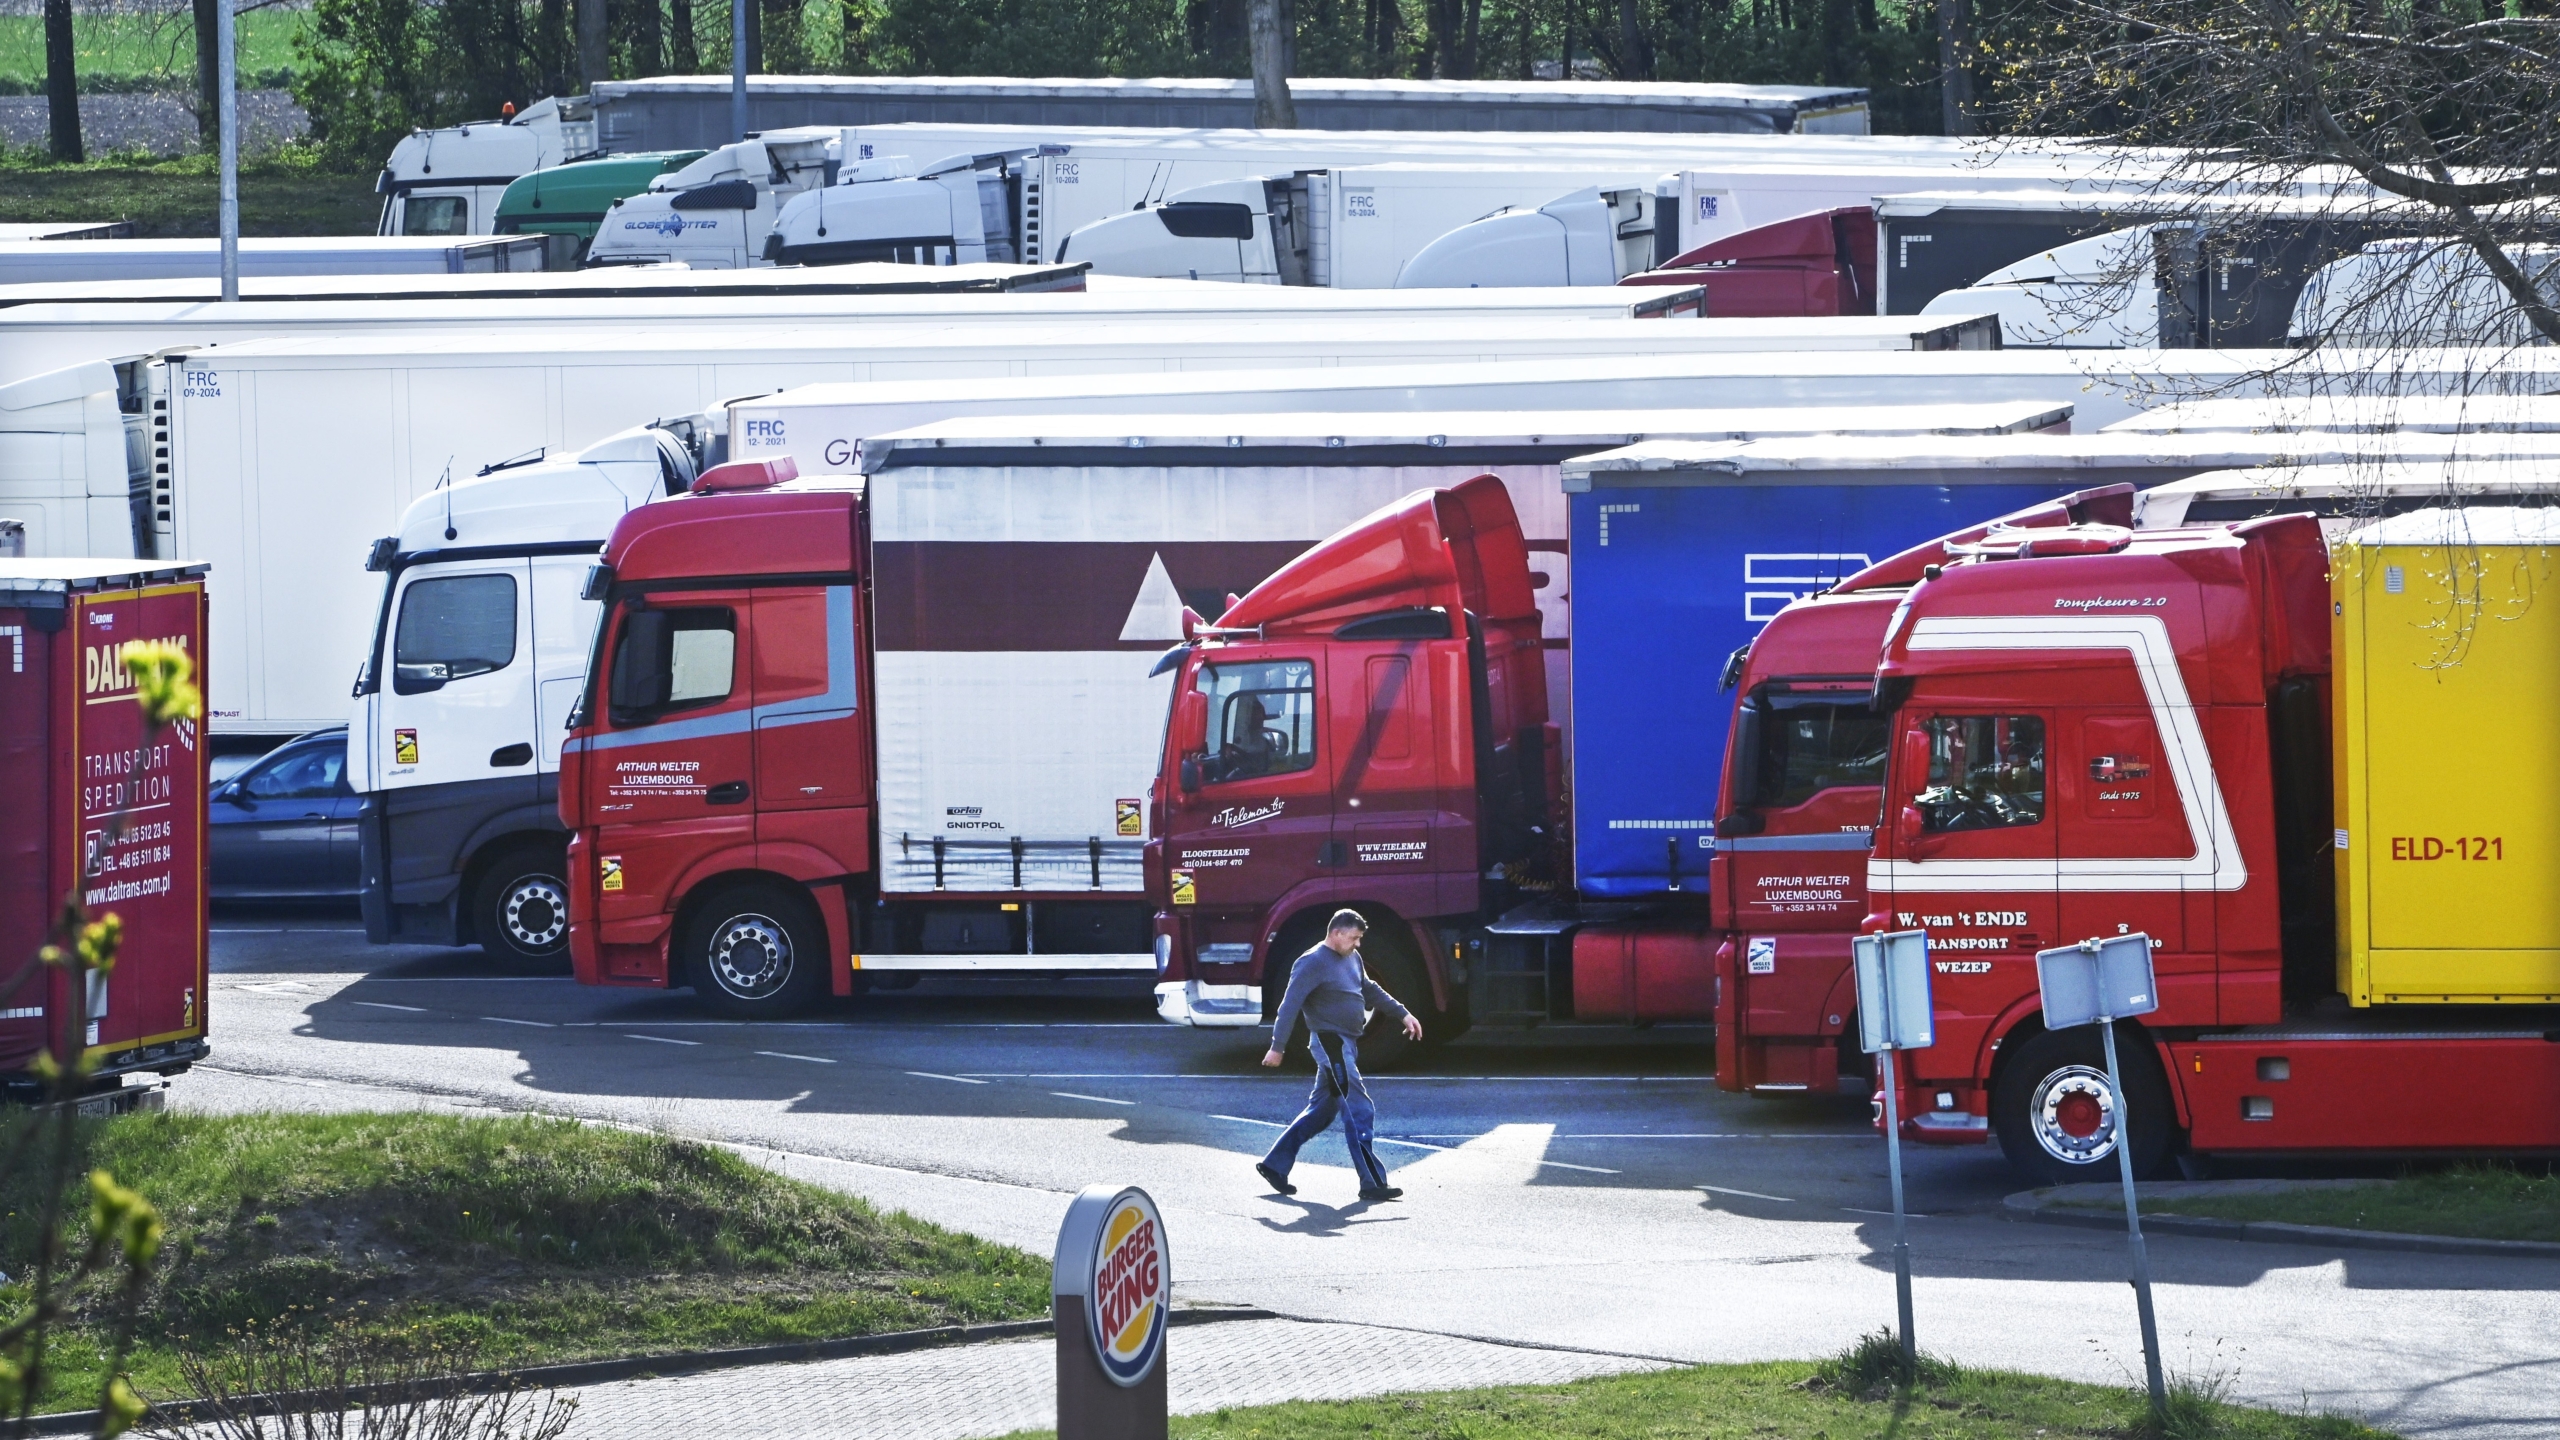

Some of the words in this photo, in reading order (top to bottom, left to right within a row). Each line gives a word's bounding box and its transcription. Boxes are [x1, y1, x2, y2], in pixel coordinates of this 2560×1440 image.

[860, 144, 874, 156] FRC
[1055, 163, 1079, 175] FRC
[1055, 176, 1079, 184] 10-2026
[1350, 196, 1374, 208] FRC
[1700, 196, 1717, 209] FRC
[1348, 209, 1375, 217] 05-2024
[187, 371, 218, 387] FRC
[747, 420, 785, 436] FRC
[765, 437, 786, 446] 2021
[2054, 597, 2139, 611] Pompkeure
[2142, 597, 2167, 607] 2.0
[95, 613, 114, 624] KRONE
[85, 744, 170, 778] TRANSPORT
[616, 762, 657, 772] ARTHUR
[660, 762, 700, 771] WELTER
[623, 775, 694, 785] LUXEMBOURG
[85, 775, 170, 811] SPEDITION
[2122, 791, 2140, 799] 1975
[1221, 806, 1271, 828] Tieleman
[946, 821, 1005, 829] GNIOTPOL
[131, 826, 139, 843] 65
[140, 824, 152, 842] 512
[153, 822, 161, 839] 23
[162, 820, 170, 837] 45
[1182, 848, 1250, 858] KLOOSTERZANDE
[1356, 842, 1427, 852] WWW.TIELEMAN
[2391, 837, 2503, 860] ELD-121
[87, 839, 100, 869] PL
[102, 855, 117, 872] TEL.
[118, 852, 130, 870] +48
[131, 850, 140, 868] 65
[141, 848, 152, 865] 511
[153, 846, 161, 863] 06
[162, 844, 170, 861] 84
[1360, 852, 1424, 862] TRANSPORT.NL
[1757, 876, 1803, 887] ARTHUR
[1805, 875, 1850, 886] WELTER
[85, 870, 170, 906] www.daltrans.com.pl
[1765, 890, 1842, 901] LUXEMBOURG
[1786, 904, 1804, 912] +352
[1898, 912, 1918, 927] W.
[1922, 915, 1954, 927] van
[1975, 911, 2027, 926] ENDE
[1927, 938, 2009, 949] RANSPORT
[1935, 961, 1992, 973] WEZEP
[1097, 1218, 1155, 1307] BURGER
[1101, 1249, 1159, 1356] KING
